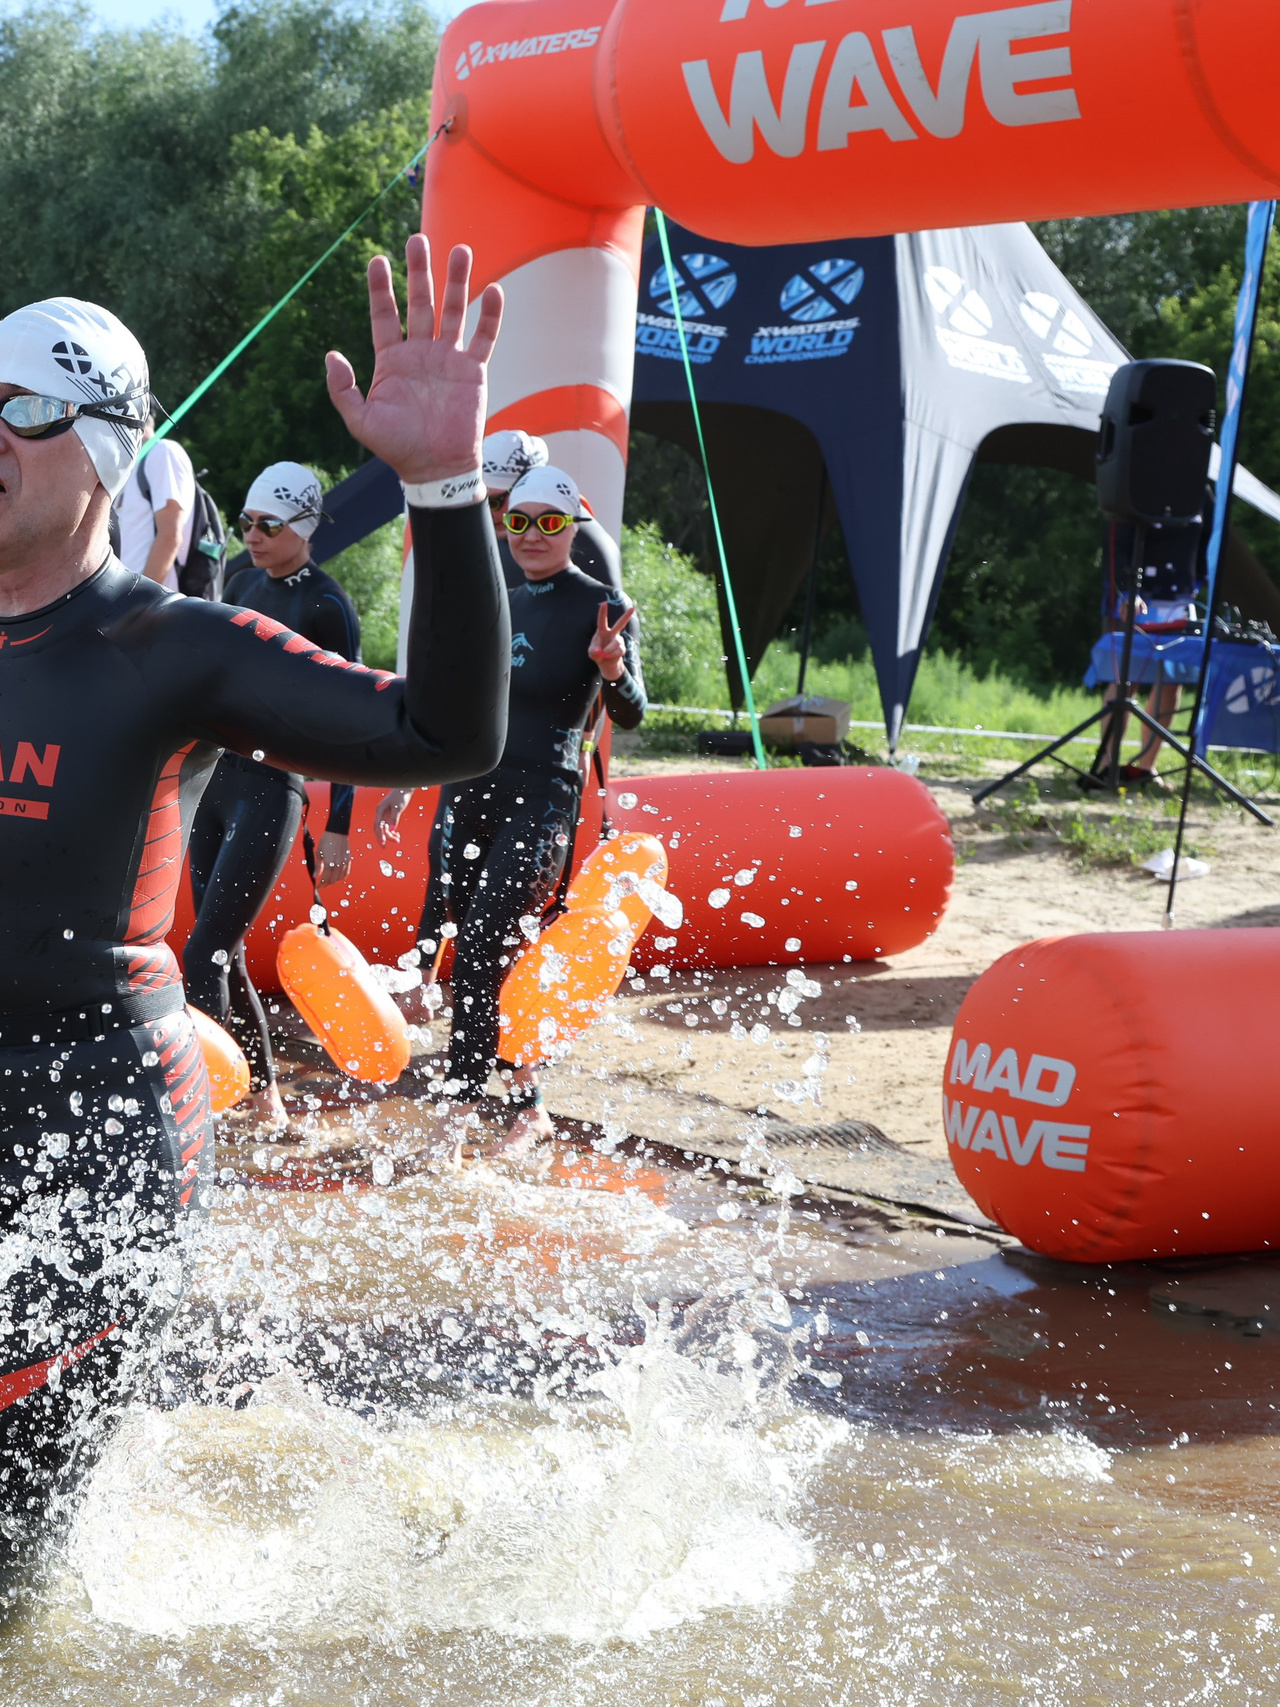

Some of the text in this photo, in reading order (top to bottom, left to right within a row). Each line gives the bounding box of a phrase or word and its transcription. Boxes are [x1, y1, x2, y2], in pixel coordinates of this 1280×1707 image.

[681, 0, 1082, 164] WAVE
[750, 329, 855, 355] WORLD
[284, 568, 312, 587] TYR
[949, 1038, 1077, 1108] MAD
[943, 1093, 1092, 1173] WAVE
